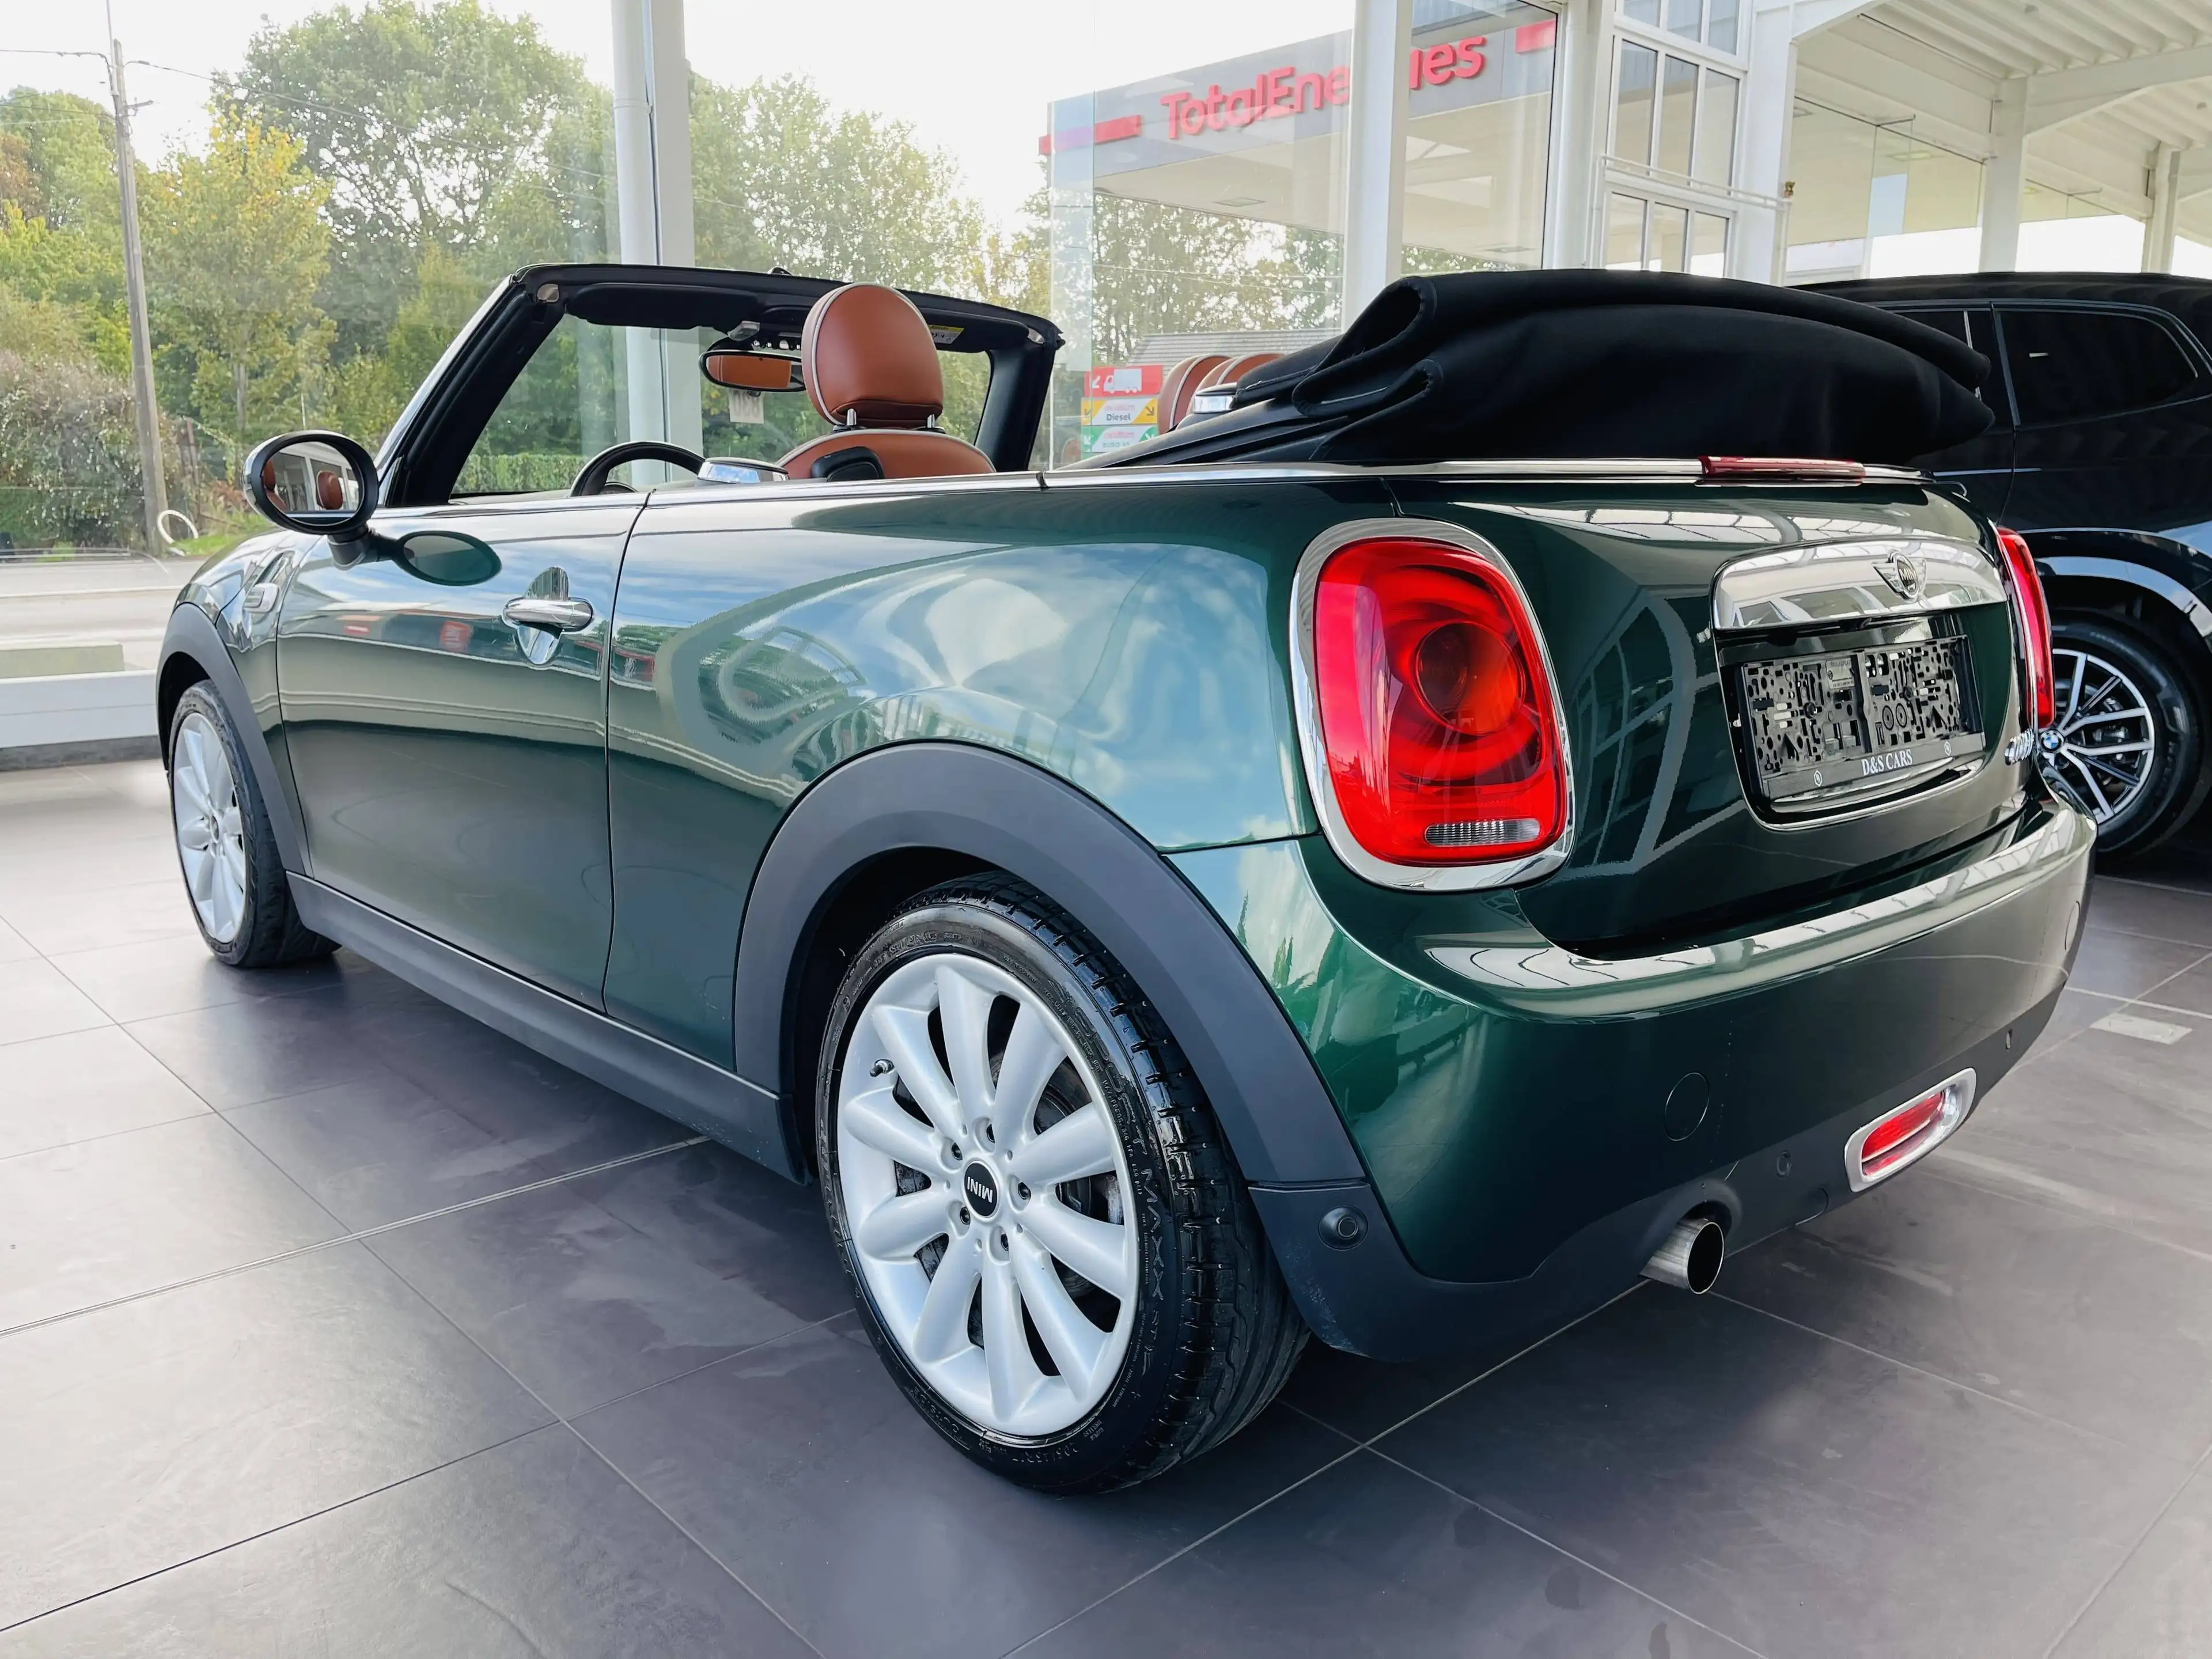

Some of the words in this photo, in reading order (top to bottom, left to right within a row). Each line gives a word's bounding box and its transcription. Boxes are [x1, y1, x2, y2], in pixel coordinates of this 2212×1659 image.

[1106, 412, 1131, 421] Diesel
[1861, 755, 1885, 776] D&S
[1885, 749, 1913, 770] CARS
[967, 1176, 994, 1203] MINI
